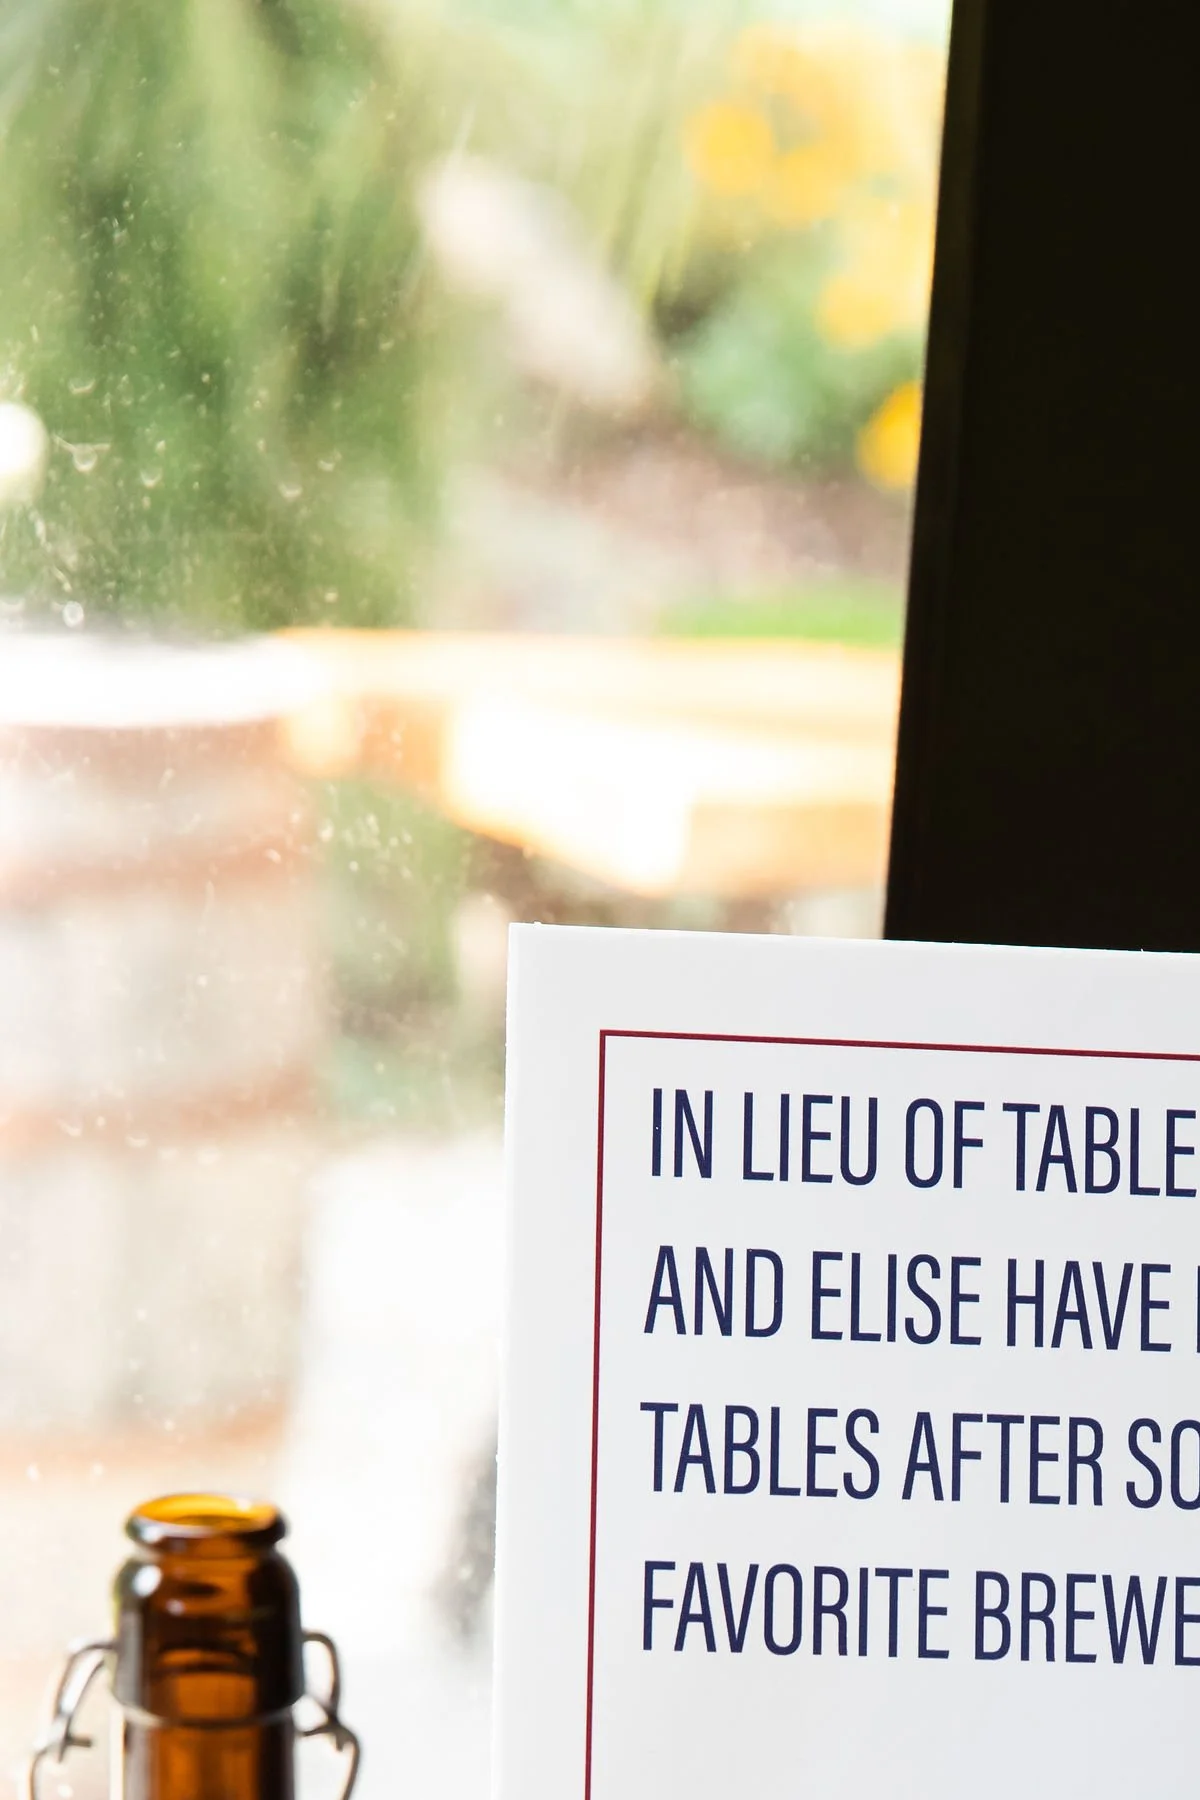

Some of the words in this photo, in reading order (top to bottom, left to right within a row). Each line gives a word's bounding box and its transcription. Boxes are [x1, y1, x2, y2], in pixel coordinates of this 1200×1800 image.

[650, 1087, 715, 1180] IN
[741, 1090, 879, 1187] LIEU
[904, 1097, 986, 1190] OF
[1001, 1101, 1198, 1199] TABLE
[642, 1244, 785, 1339] AND
[810, 1249, 983, 1347] ELISE
[1005, 1257, 1173, 1354] HAVE
[638, 1400, 881, 1501] TABLES
[900, 1410, 1105, 1507] AFTER
[642, 1559, 951, 1660] FAVORITE
